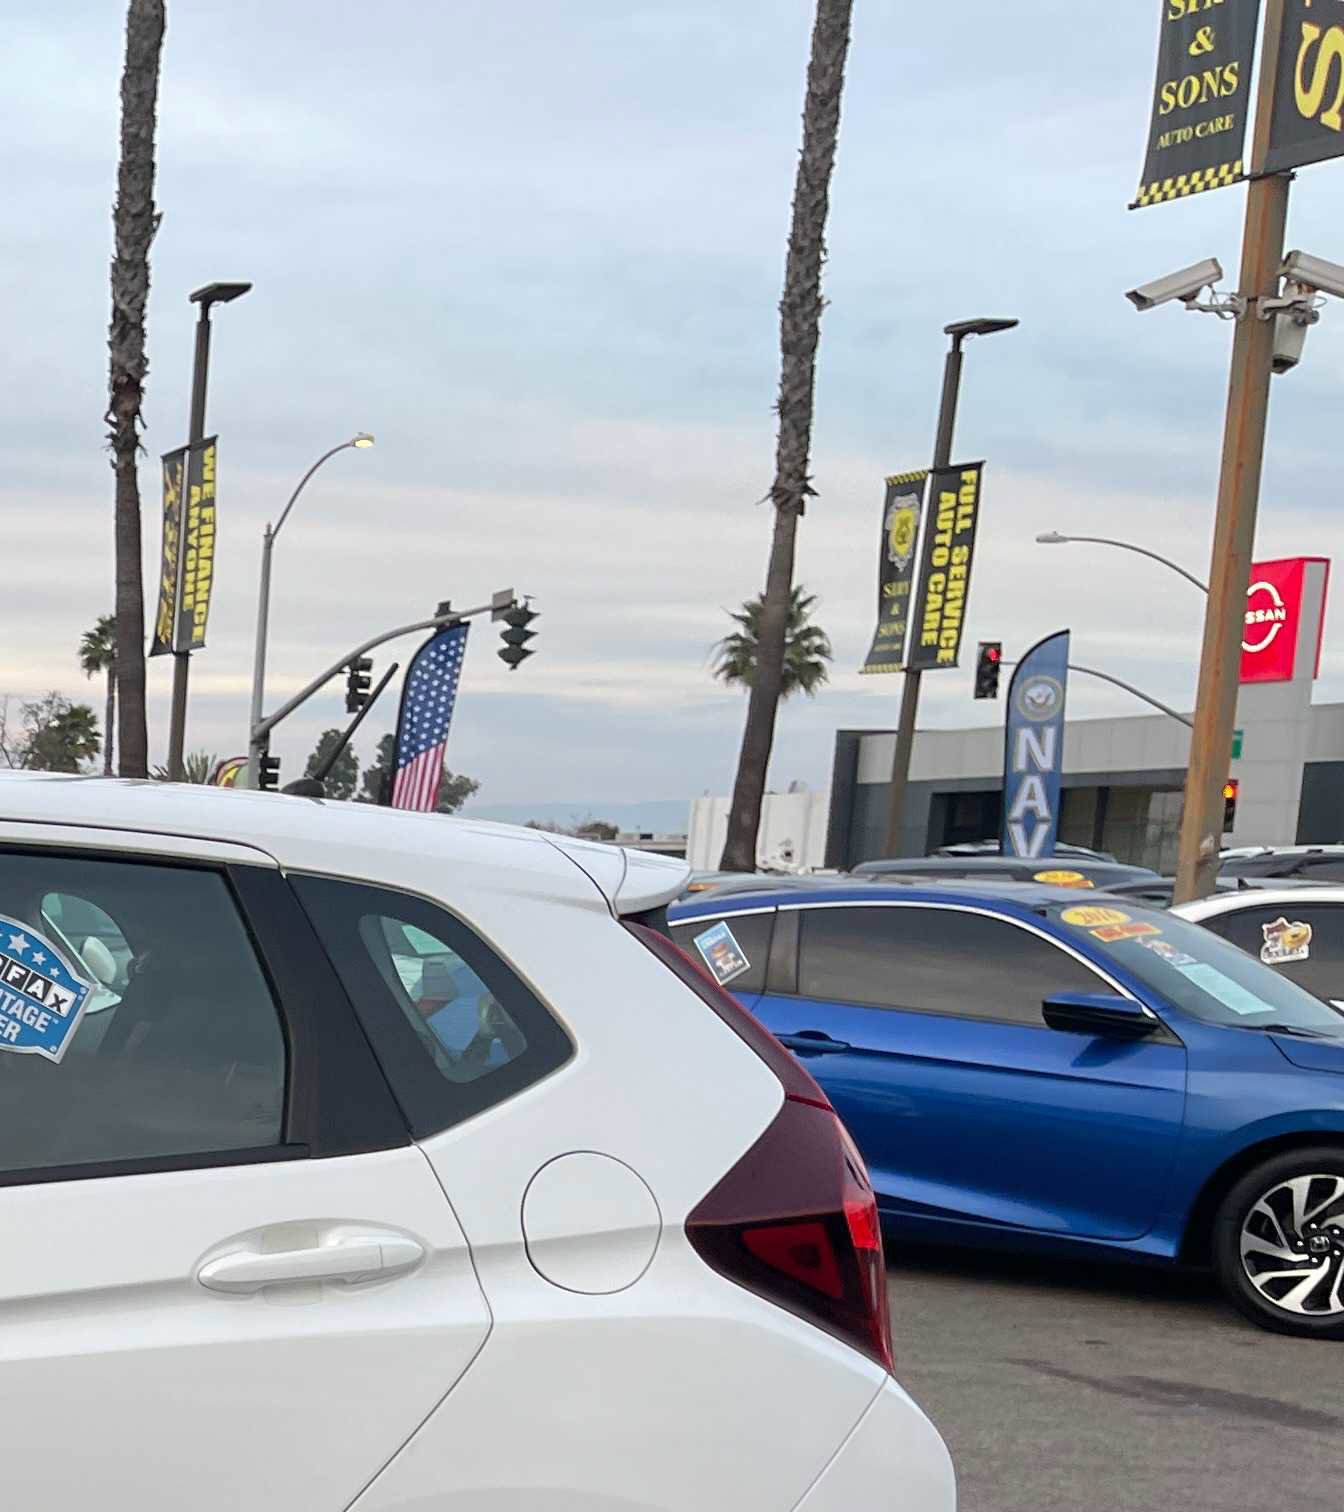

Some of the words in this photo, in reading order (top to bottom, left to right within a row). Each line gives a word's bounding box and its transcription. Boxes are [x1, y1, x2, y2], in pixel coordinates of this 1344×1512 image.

[1188, 26, 1215, 56] &
[1159, 61, 1239, 115] SONS
[1157, 126, 1193, 149] AUTO
[1195, 114, 1234, 138] CARE
[202, 445, 215, 500] WE
[955, 469, 977, 534] FULL
[183, 485, 201, 611] ANYONE
[932, 492, 957, 567] AUTO
[192, 507, 214, 642] FINANCE
[921, 572, 946, 647] CARE
[937, 545, 969, 663] SERVICE
[1245, 608, 1286, 625] SSAN
[1008, 727, 1055, 858] NAV
